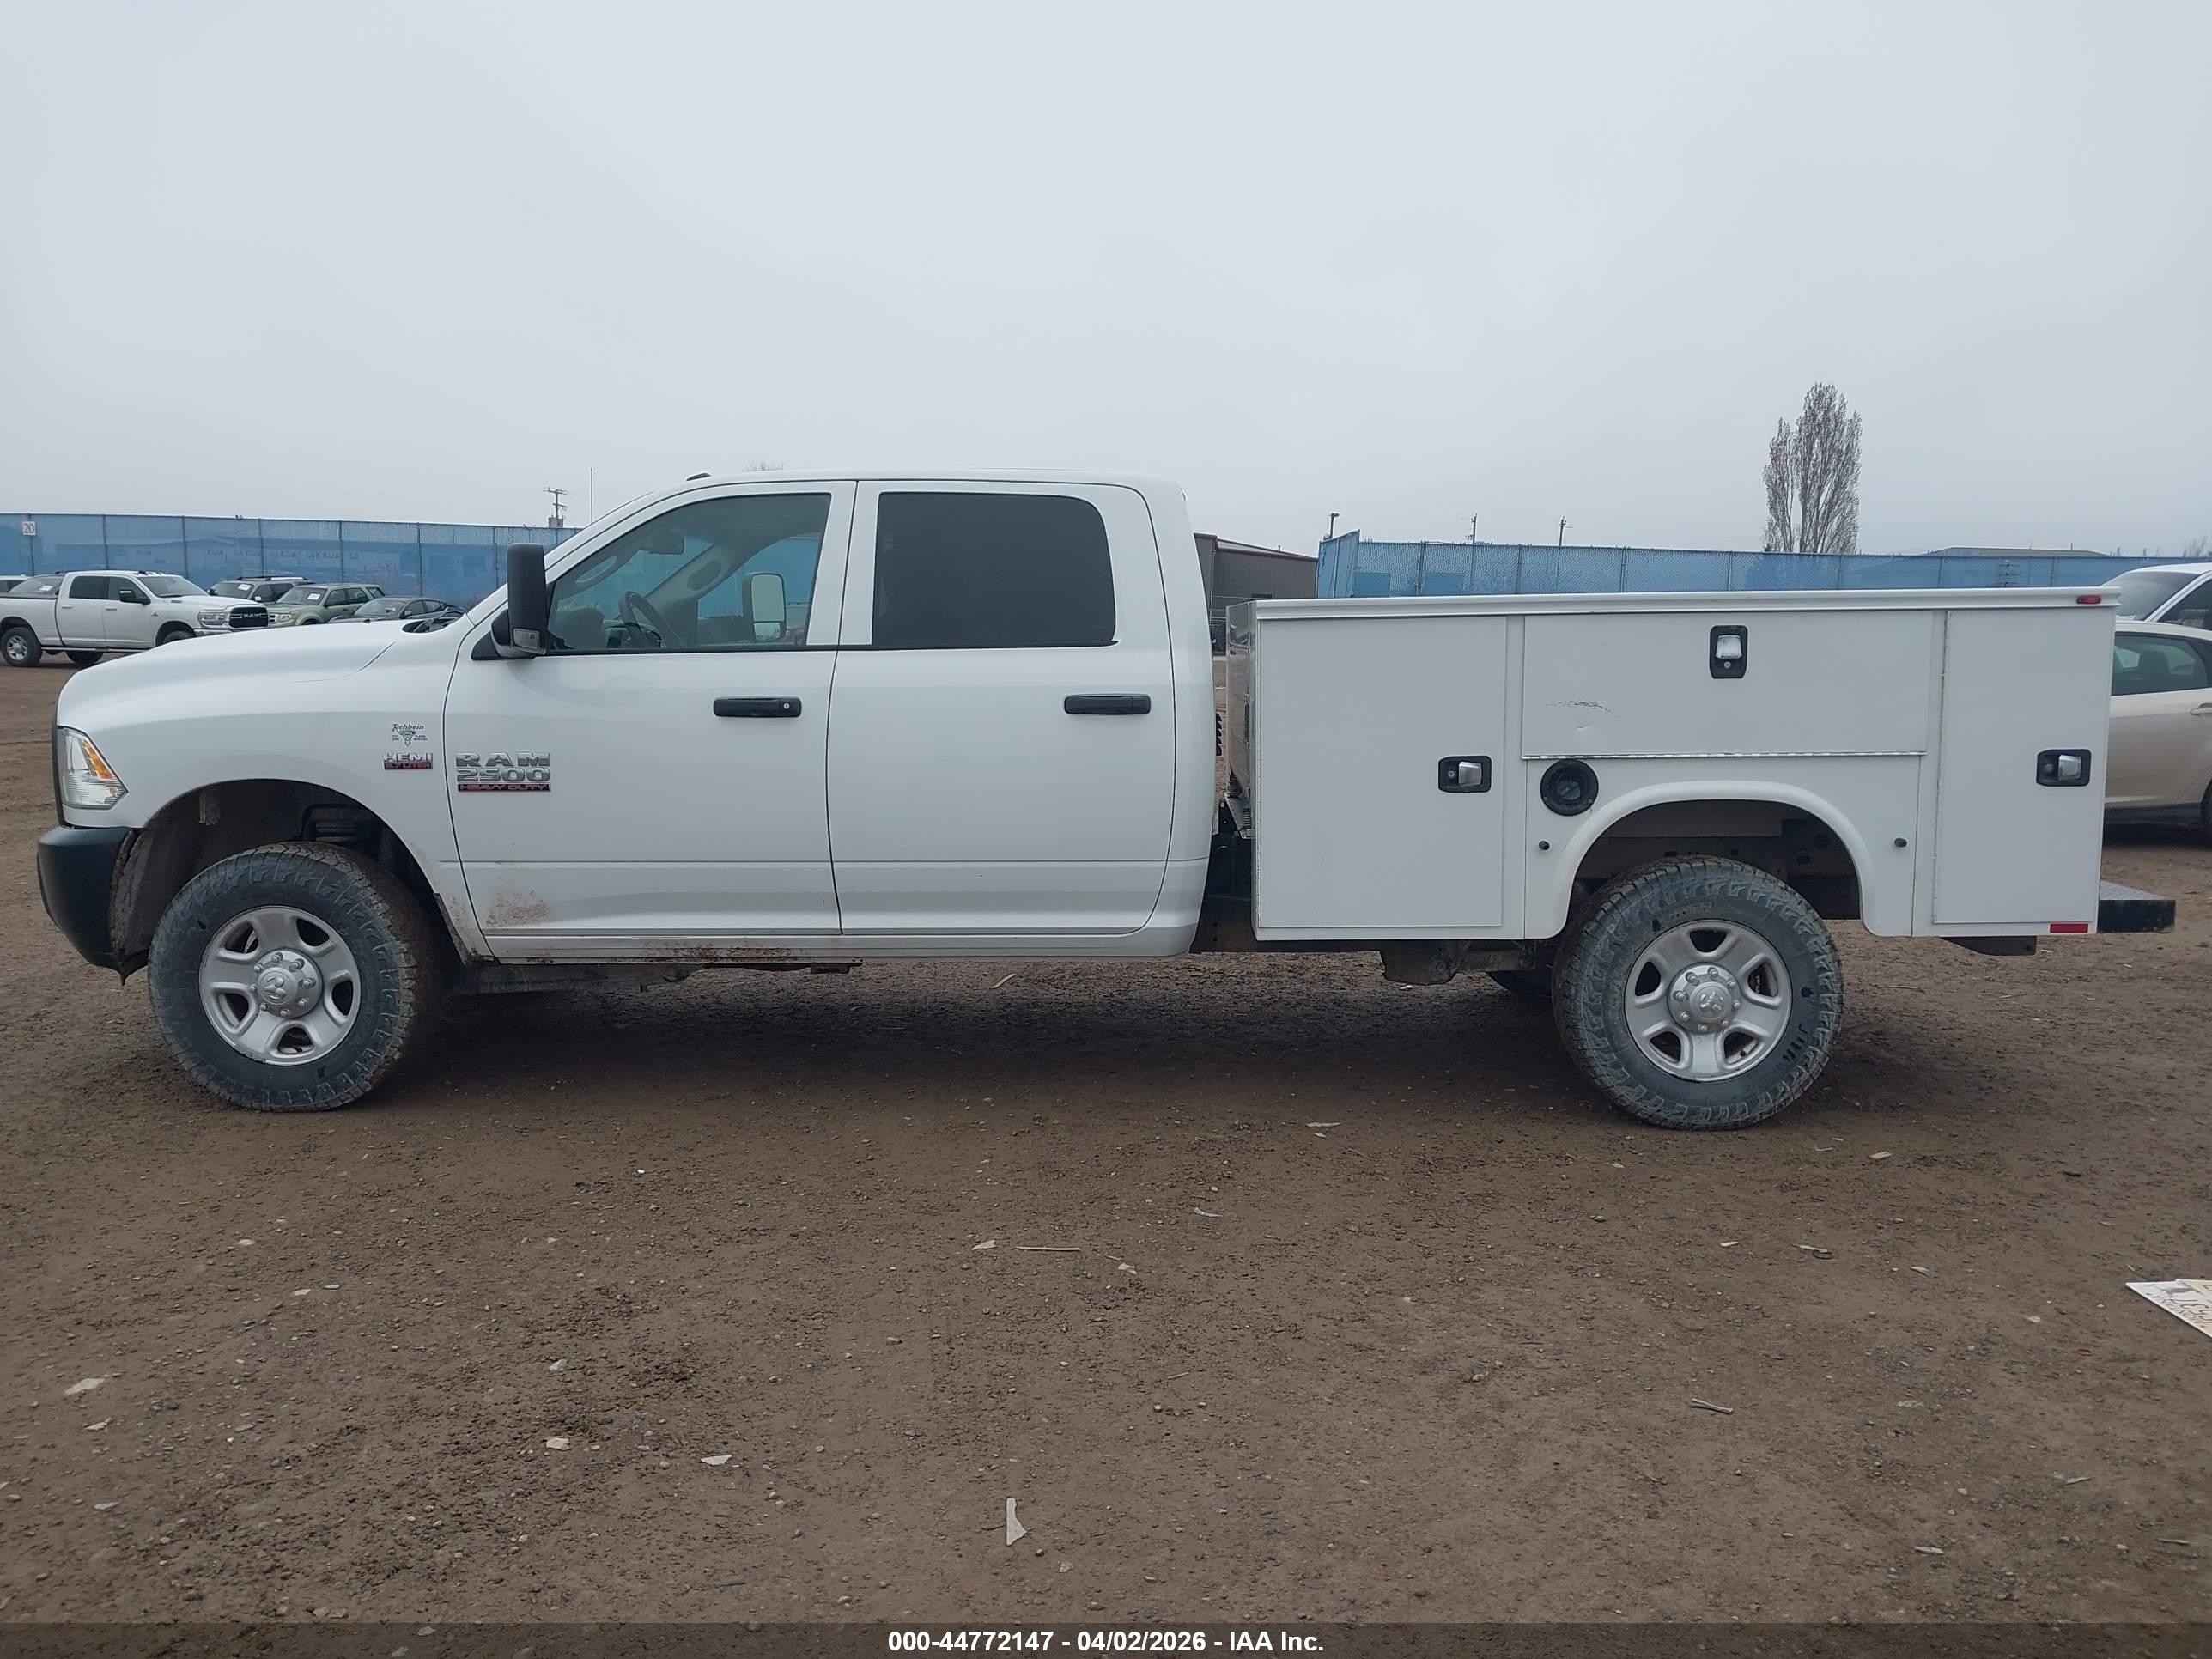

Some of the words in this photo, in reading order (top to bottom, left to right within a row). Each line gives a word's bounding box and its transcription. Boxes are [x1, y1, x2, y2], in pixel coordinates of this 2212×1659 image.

[24, 523, 35, 533] 20
[391, 723, 424, 733] Rehbein
[384, 752, 433, 762] HEMI
[455, 752, 550, 767] RAM
[457, 767, 550, 781] 2500
